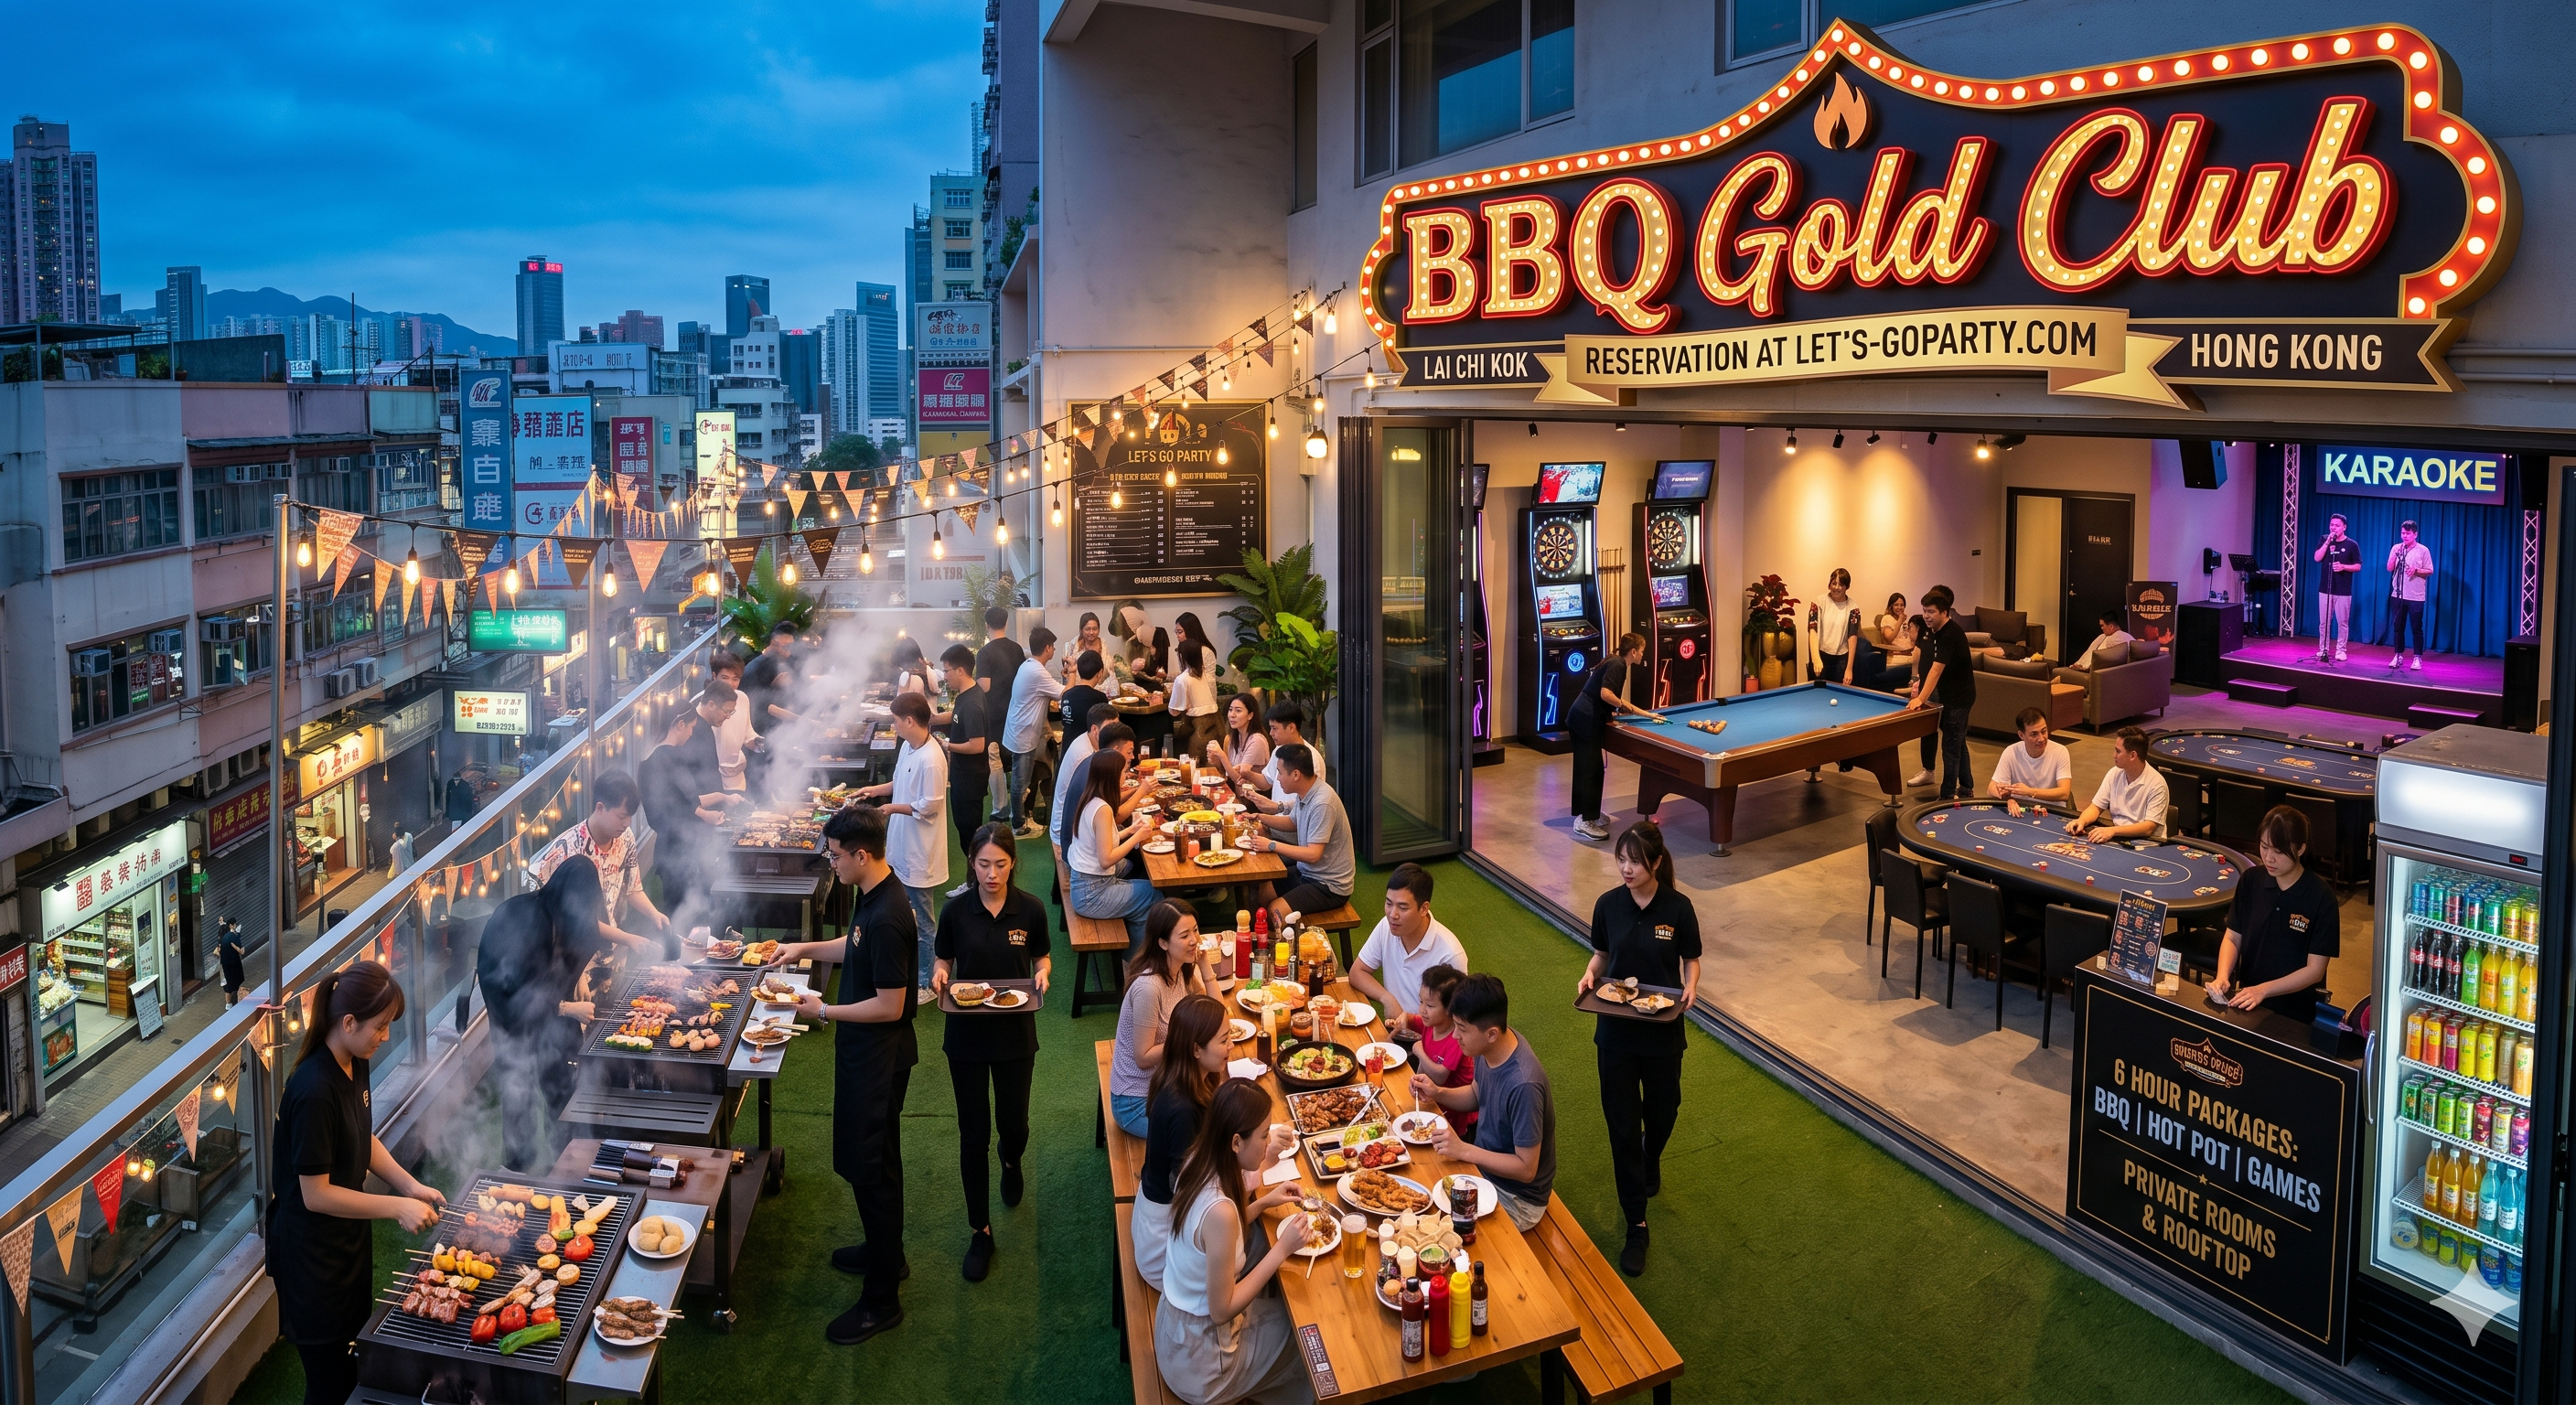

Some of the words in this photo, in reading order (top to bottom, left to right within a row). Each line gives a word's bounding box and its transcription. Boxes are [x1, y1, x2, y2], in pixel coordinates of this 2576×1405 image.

[1402, 177, 1681, 335] BBQ
[1695, 136, 1997, 317] Gold
[2018, 96, 2398, 292] Club
[1424, 355, 1451, 380] LAI
[1456, 353, 1485, 379] CHI
[1491, 351, 1529, 378] KOK
[1585, 339, 1748, 376] RESERVATION
[1755, 336, 1788, 369] AT
[1796, 320, 2097, 365] LET'S-GOPARTY.COM
[2191, 332, 2279, 370] HONG
[2290, 333, 2383, 371] KONG
[1159, 449, 1174, 463] GO
[1176, 449, 1212, 463] PARTY
[2324, 453, 2497, 492] KARAOKE
[2114, 1058, 2126, 1086] 6
[2131, 1065, 2181, 1113] HOUR
[2187, 1089, 2299, 1163] PACKAGES:
[2095, 1086, 2130, 1132] BBQ
[2148, 1110, 2186, 1151] HOT
[2191, 1130, 2230, 1171] POT
[2248, 1155, 2321, 1213] GAMES
[2124, 1159, 2199, 1221] PRIVATE
[2206, 1199, 2276, 1259] ROOMS
[2142, 1204, 2157, 1235] &
[2163, 1214, 2251, 1281] ROOFTOP
